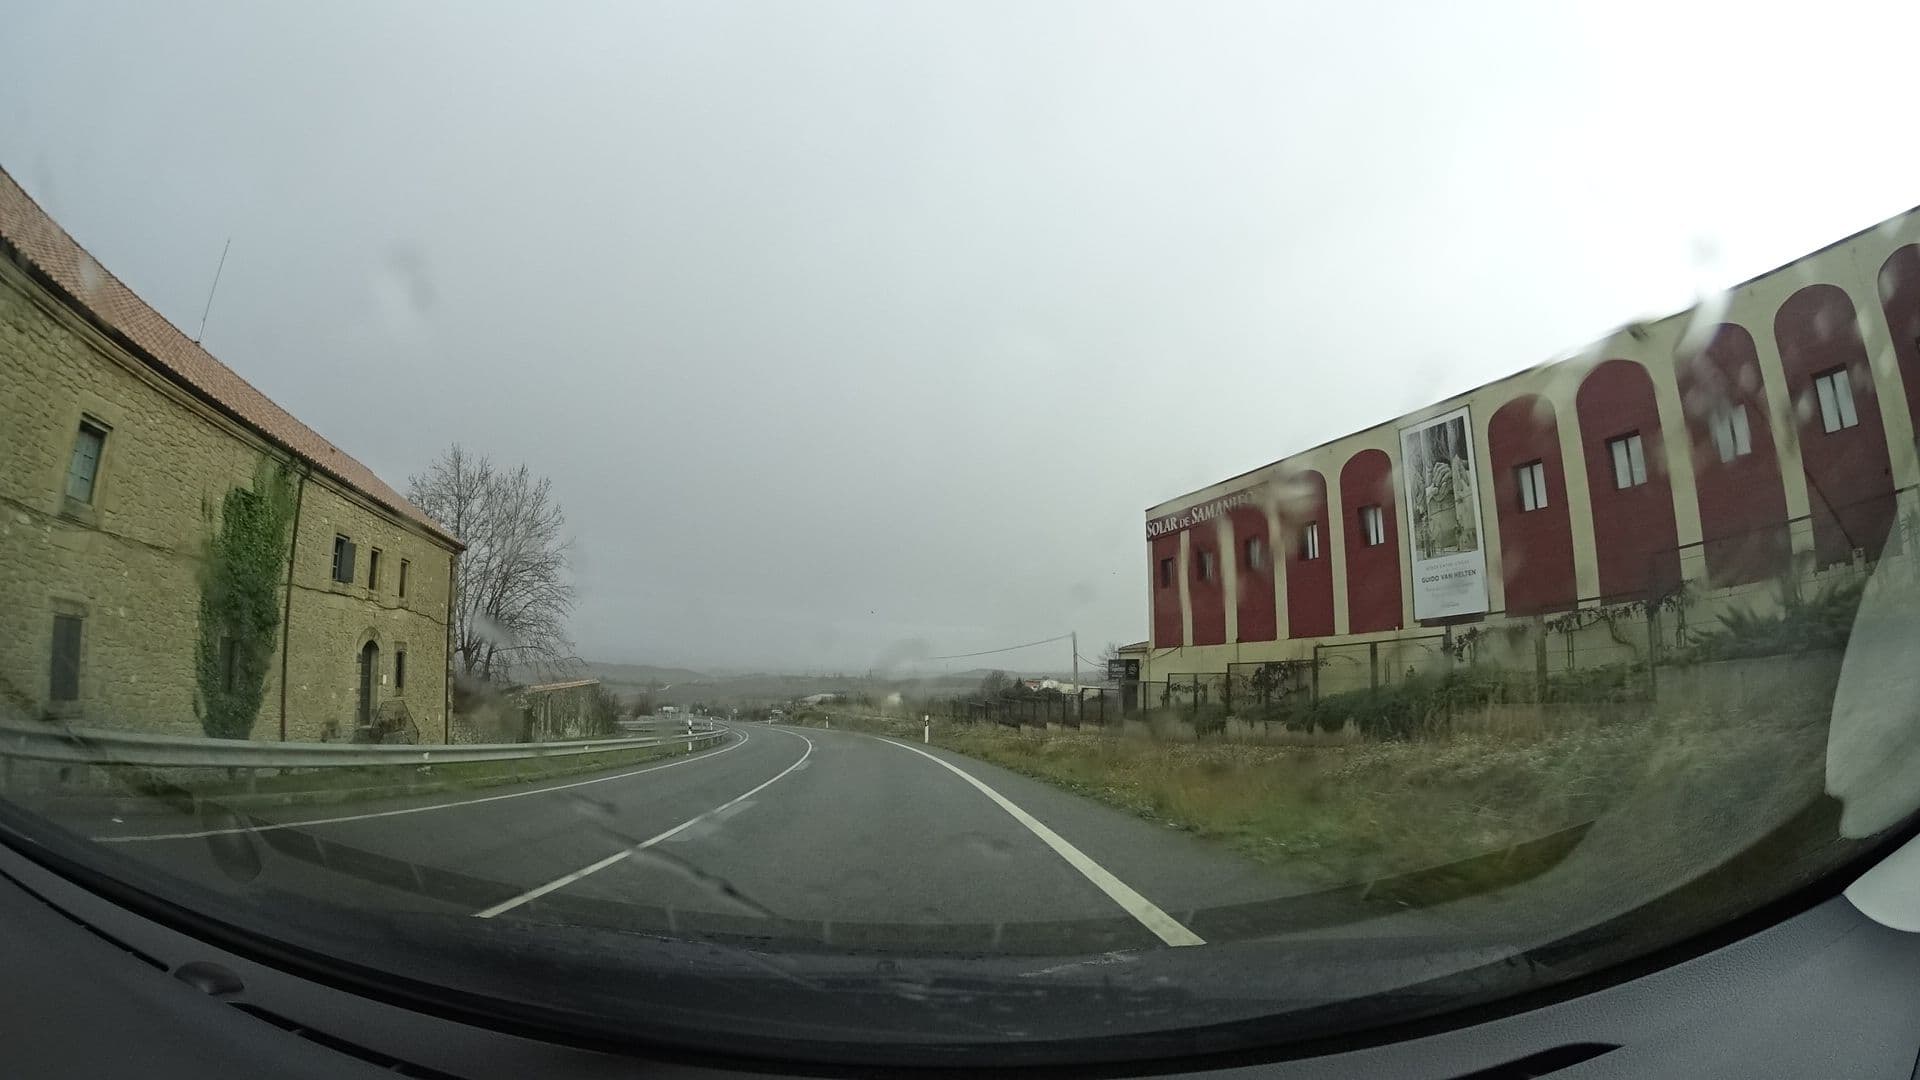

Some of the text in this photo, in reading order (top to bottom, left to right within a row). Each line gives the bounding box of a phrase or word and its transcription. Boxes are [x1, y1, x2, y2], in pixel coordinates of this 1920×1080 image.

[1146, 516, 1178, 538] SOLAR
[1421, 575, 1439, 584] GUIDO
[1441, 572, 1453, 580] VAN
